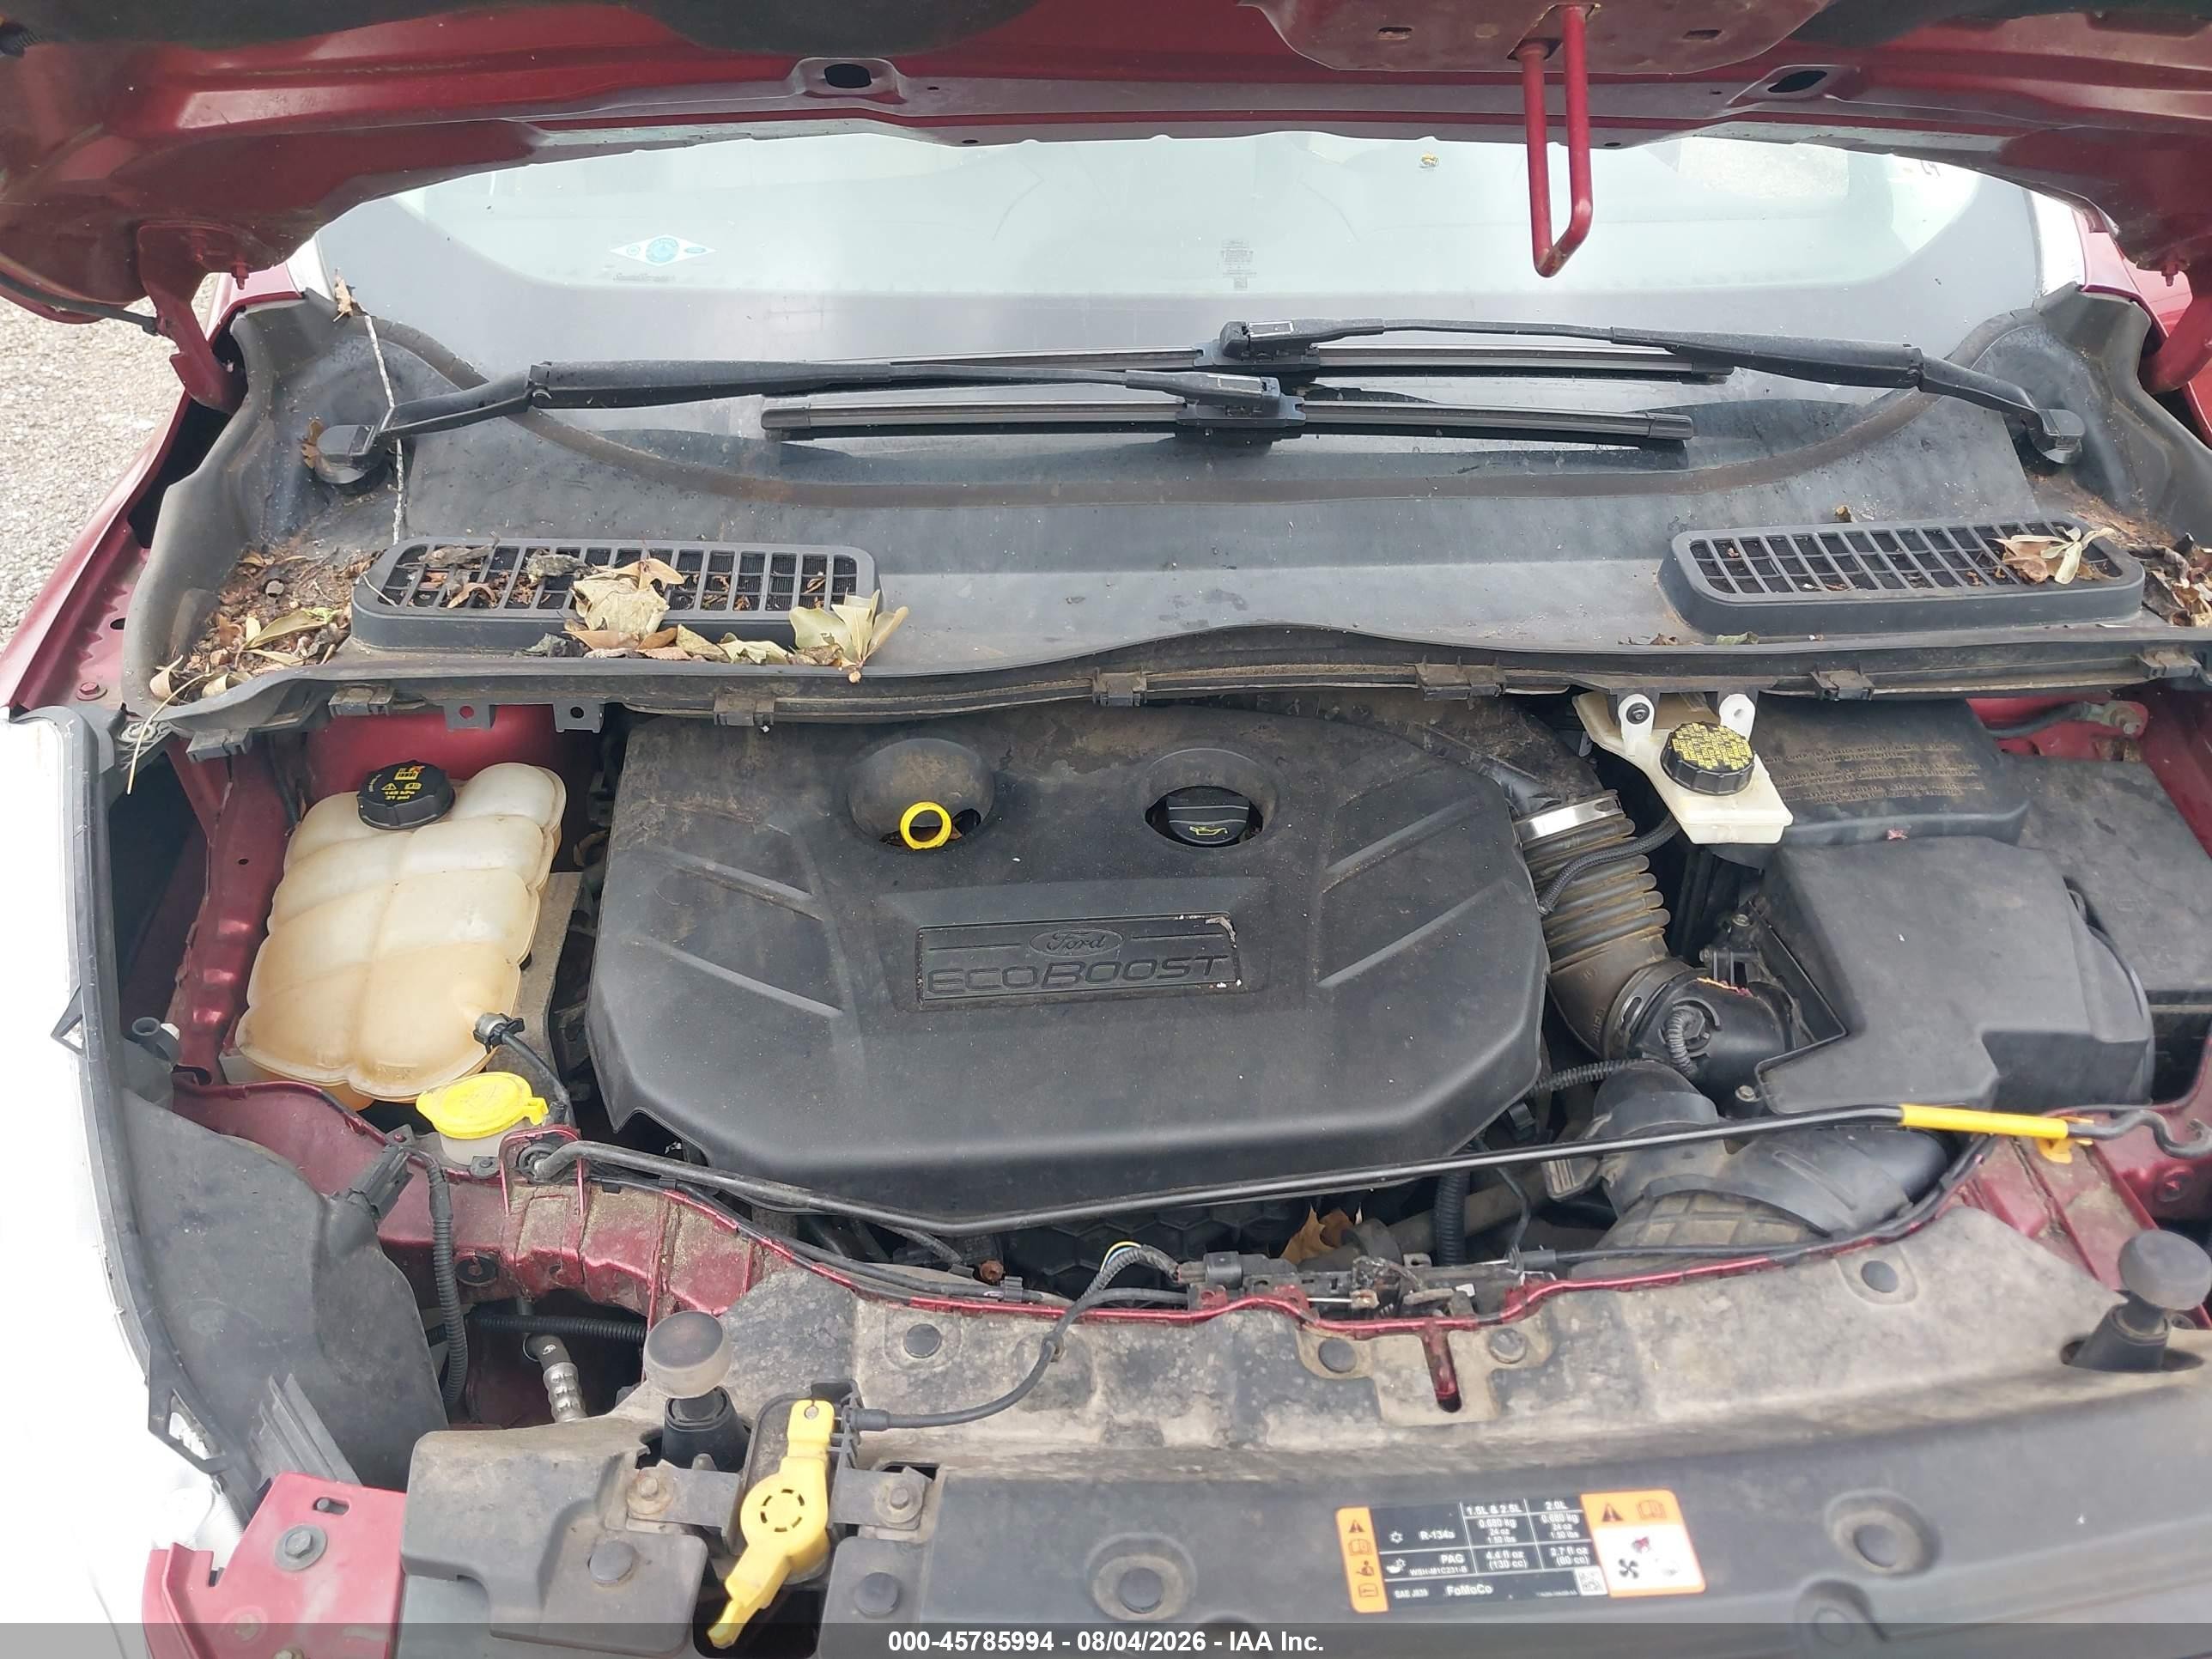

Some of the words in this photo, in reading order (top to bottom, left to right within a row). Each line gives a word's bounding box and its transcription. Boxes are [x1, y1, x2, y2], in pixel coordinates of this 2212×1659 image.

[1046, 931, 1107, 952] Ford
[927, 954, 1230, 994] ECOBOOST
[1440, 1553, 1465, 1564] PAG
[1446, 1583, 1494, 1596] FoMoCo
